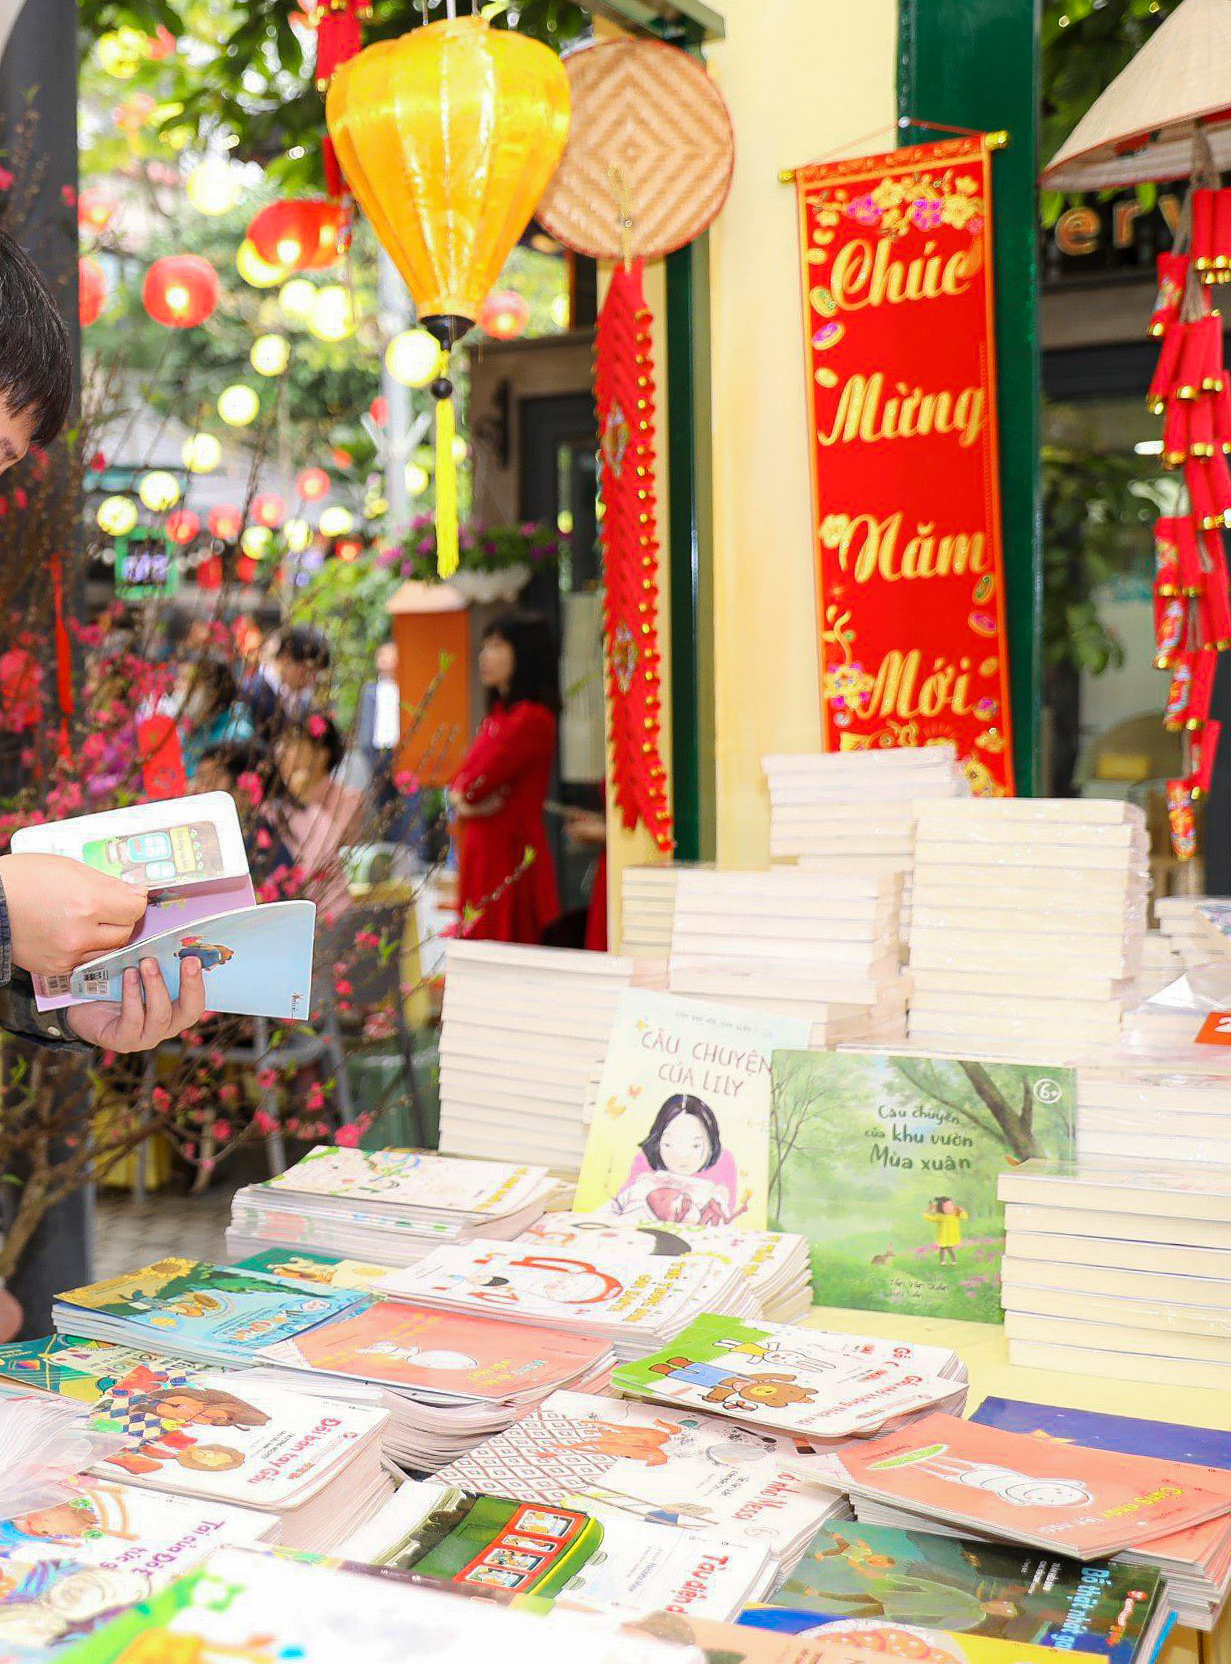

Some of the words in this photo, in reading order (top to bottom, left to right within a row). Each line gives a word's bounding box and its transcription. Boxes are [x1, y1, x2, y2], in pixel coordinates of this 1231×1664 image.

[830, 237, 983, 311] Chúc
[818, 372, 985, 448] Mừng
[839, 511, 992, 584] Năm
[858, 649, 975, 719] Mới
[641, 1027, 680, 1055] CÂU
[692, 1041, 772, 1077] CHUYỆN
[658, 1062, 695, 1087] CỦA
[702, 1076, 744, 1097] LILY
[878, 1105, 907, 1119] Câu
[892, 1123, 924, 1143] khu
[930, 1132, 974, 1147] vườn
[870, 1143, 913, 1169] Mùa
[921, 1155, 971, 1171] xuân
[269, 1453, 299, 1468] tay
[730, 1496, 788, 1521] Messi
[1080, 1567, 1113, 1586] Bố
